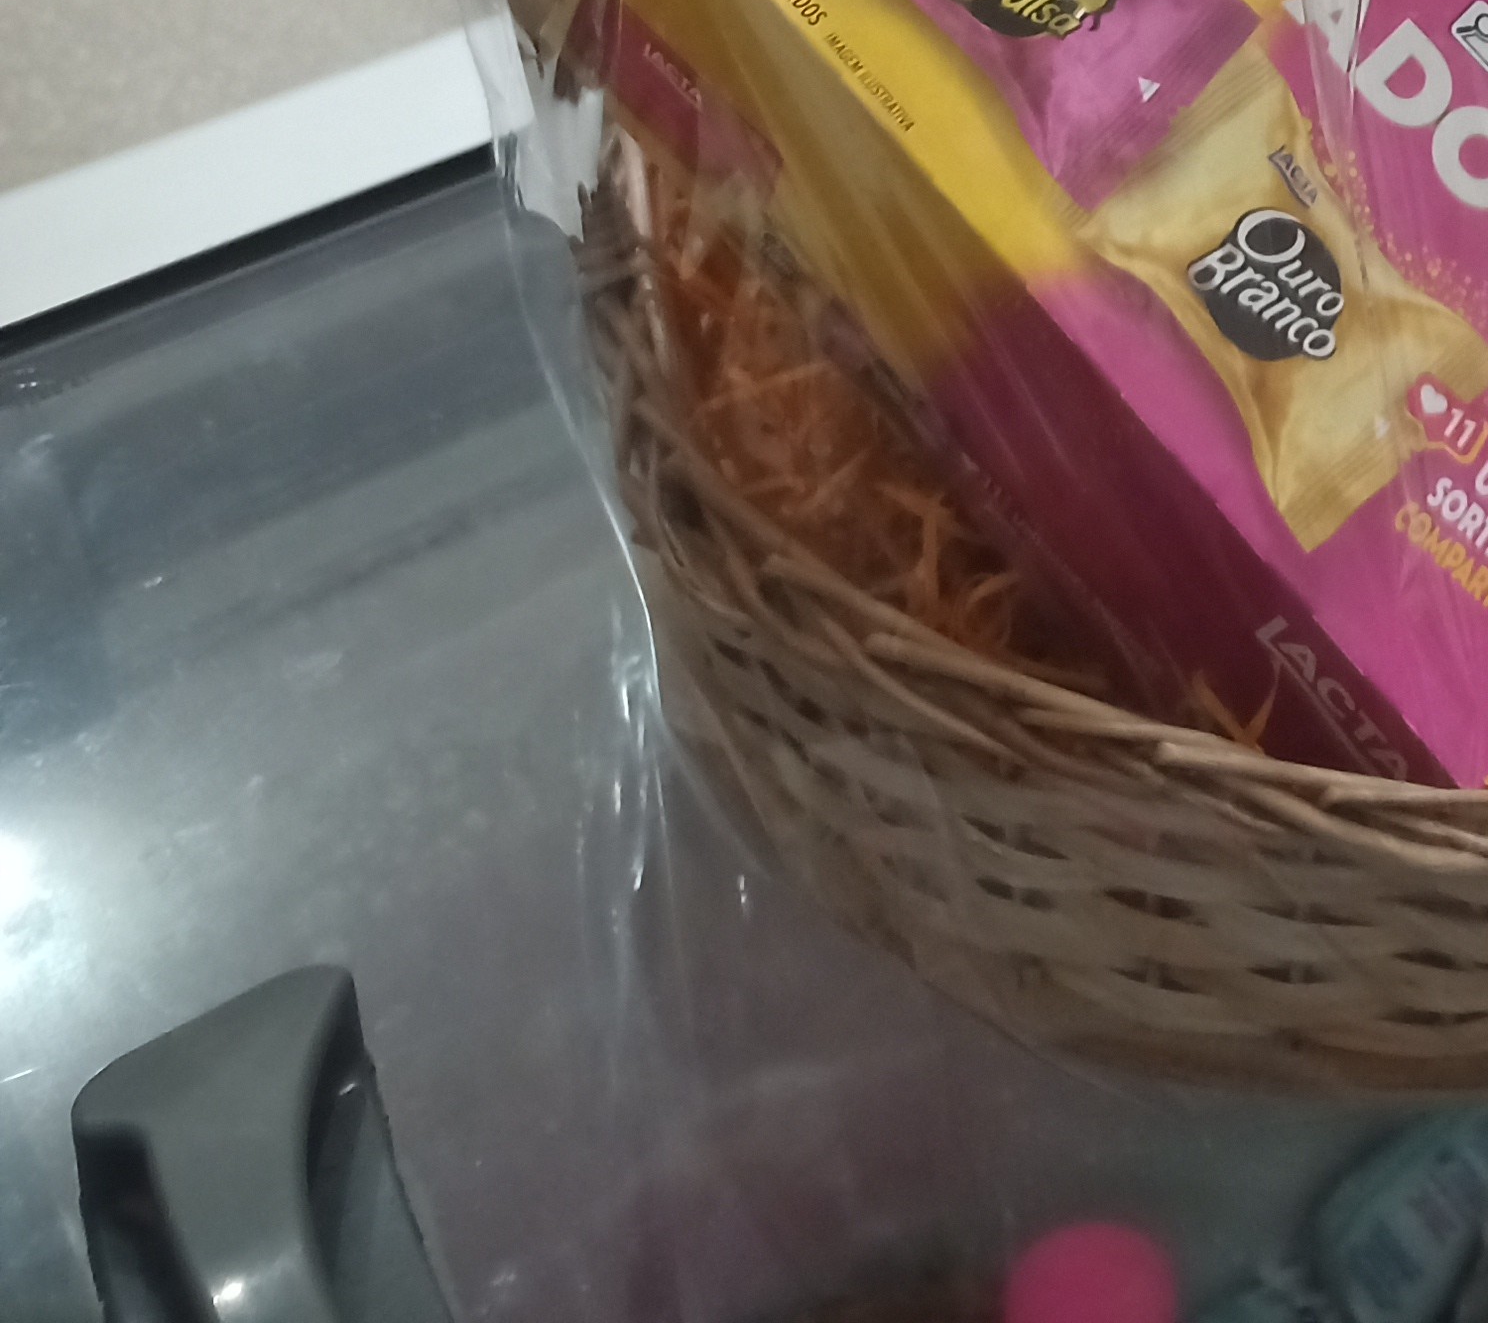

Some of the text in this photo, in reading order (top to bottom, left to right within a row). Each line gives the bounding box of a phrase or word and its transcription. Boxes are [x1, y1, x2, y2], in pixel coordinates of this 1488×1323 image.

[824, 32, 863, 71] IMAGEM
[1187, 242, 1336, 357] Branco
[1237, 209, 1344, 316] Ouro
[1443, 406, 1477, 449] 11
[1255, 615, 1408, 782] LACTA
